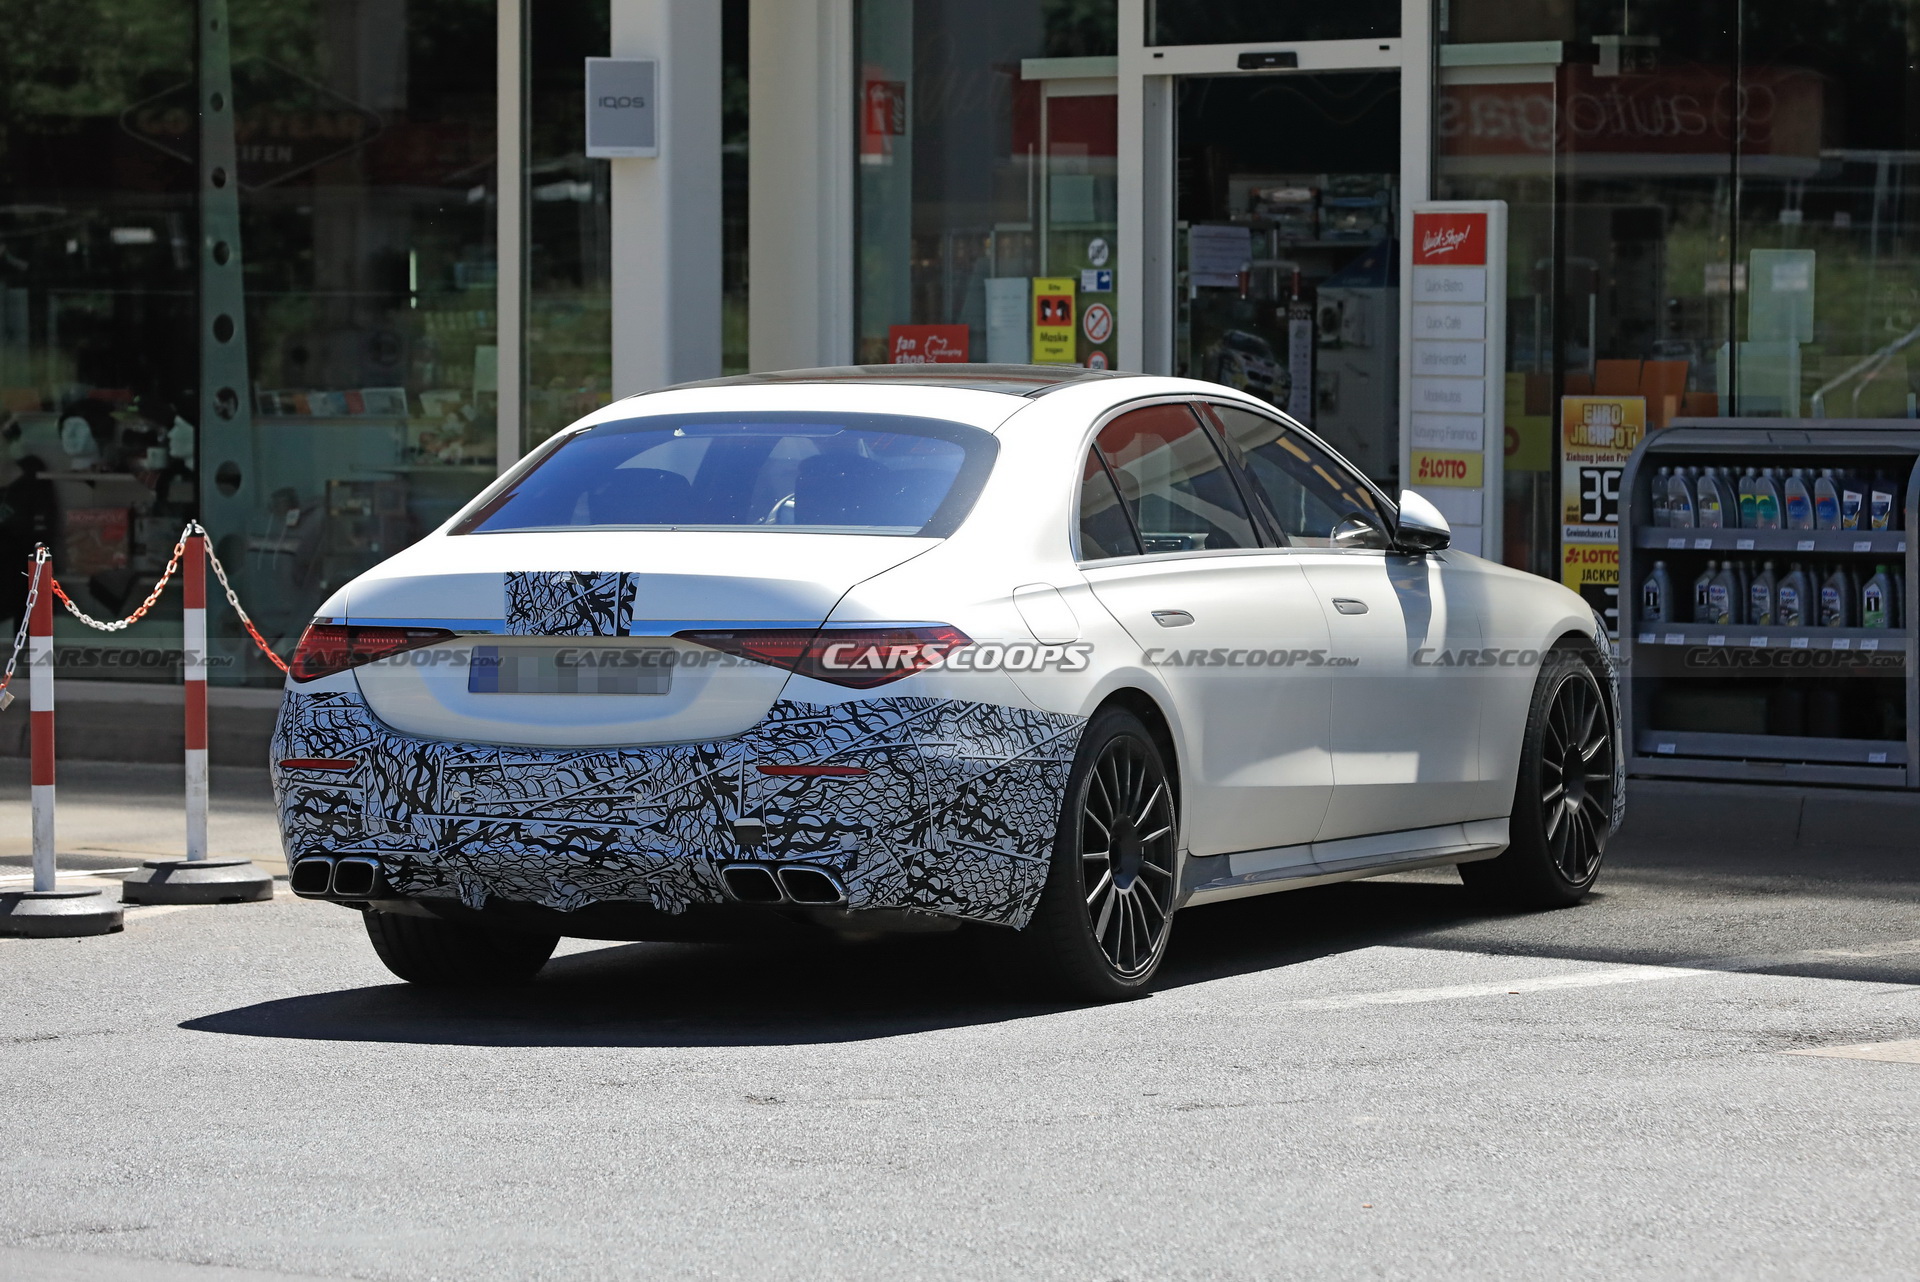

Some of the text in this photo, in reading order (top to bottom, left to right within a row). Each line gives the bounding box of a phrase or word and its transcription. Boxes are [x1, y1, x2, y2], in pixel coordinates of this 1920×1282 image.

[598, 96, 646, 110] IQOS
[1040, 332, 1069, 343] Maske
[1582, 403, 1623, 425] EURO
[1569, 424, 1637, 450] JACKPOT
[1566, 453, 1594, 464] Ziehung
[1595, 453, 1615, 464] jeden
[1430, 458, 1467, 479] LOTTO
[1581, 569, 1620, 582] JACKPO
